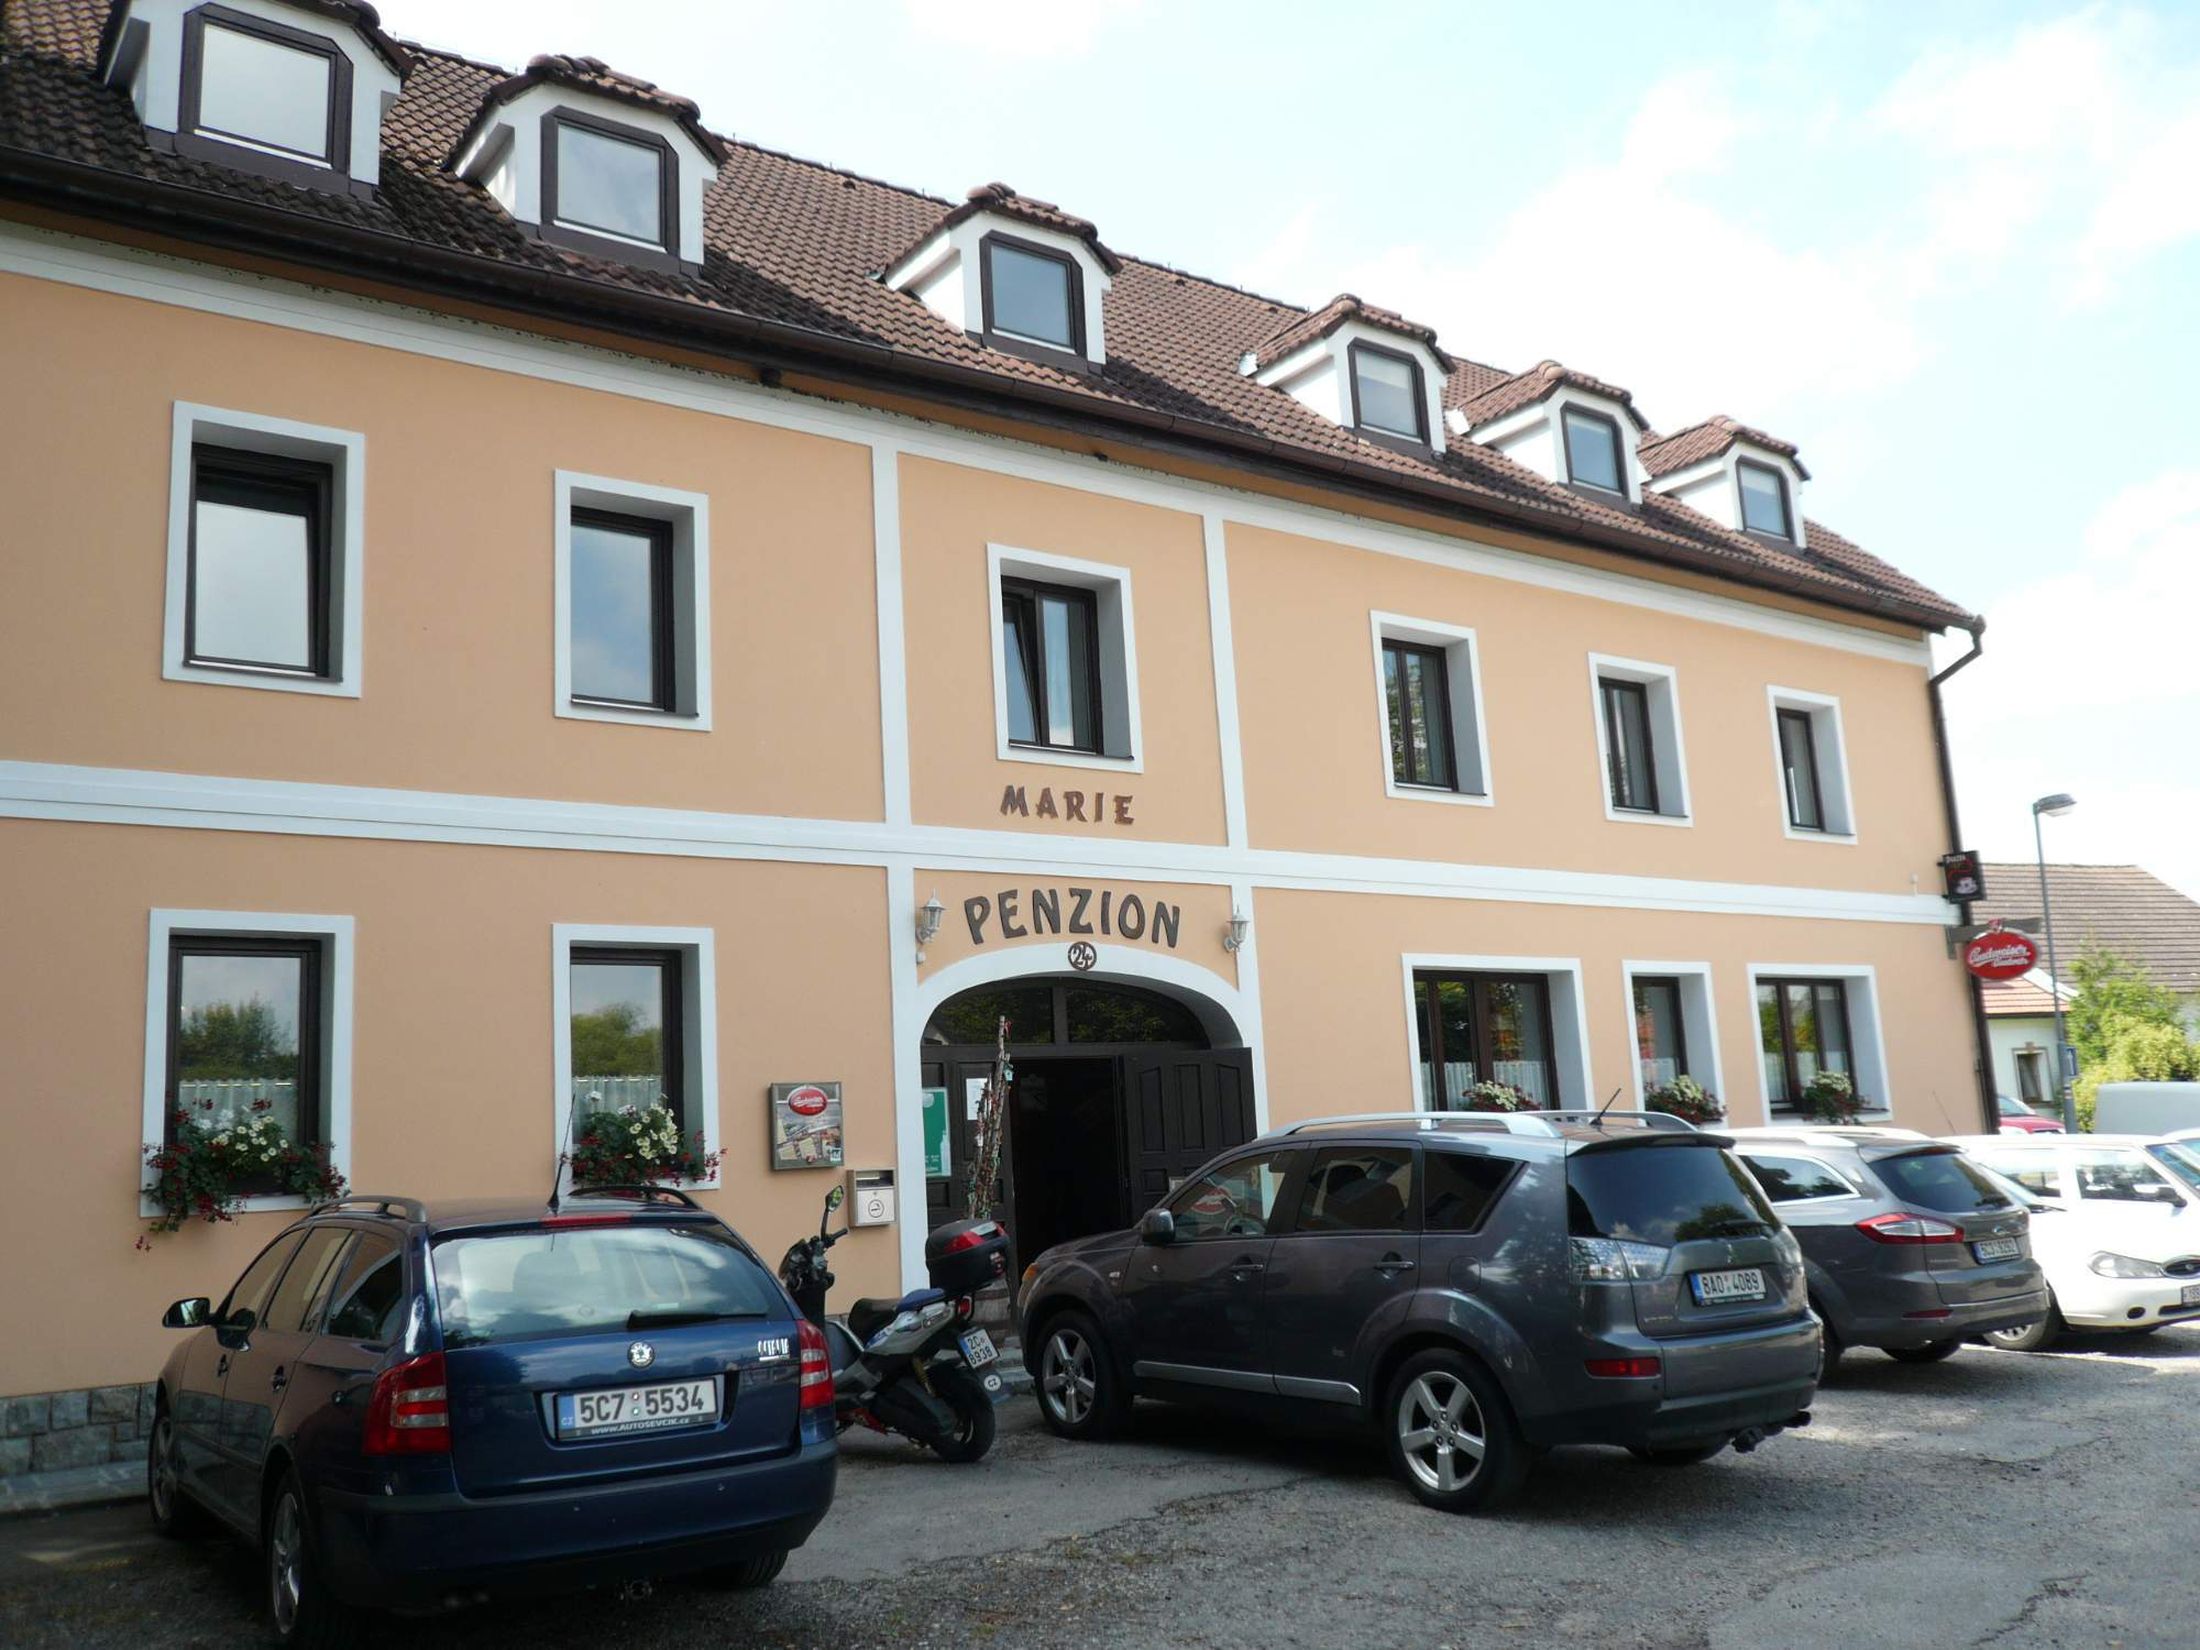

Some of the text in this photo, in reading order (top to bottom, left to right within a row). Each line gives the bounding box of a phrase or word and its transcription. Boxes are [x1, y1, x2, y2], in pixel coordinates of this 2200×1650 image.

[1000, 785, 1135, 825] MARIE
[964, 888, 1180, 948] PENZION
[1071, 943, 1093, 969] 24
[580, 1384, 704, 1424] 5C7 5534
